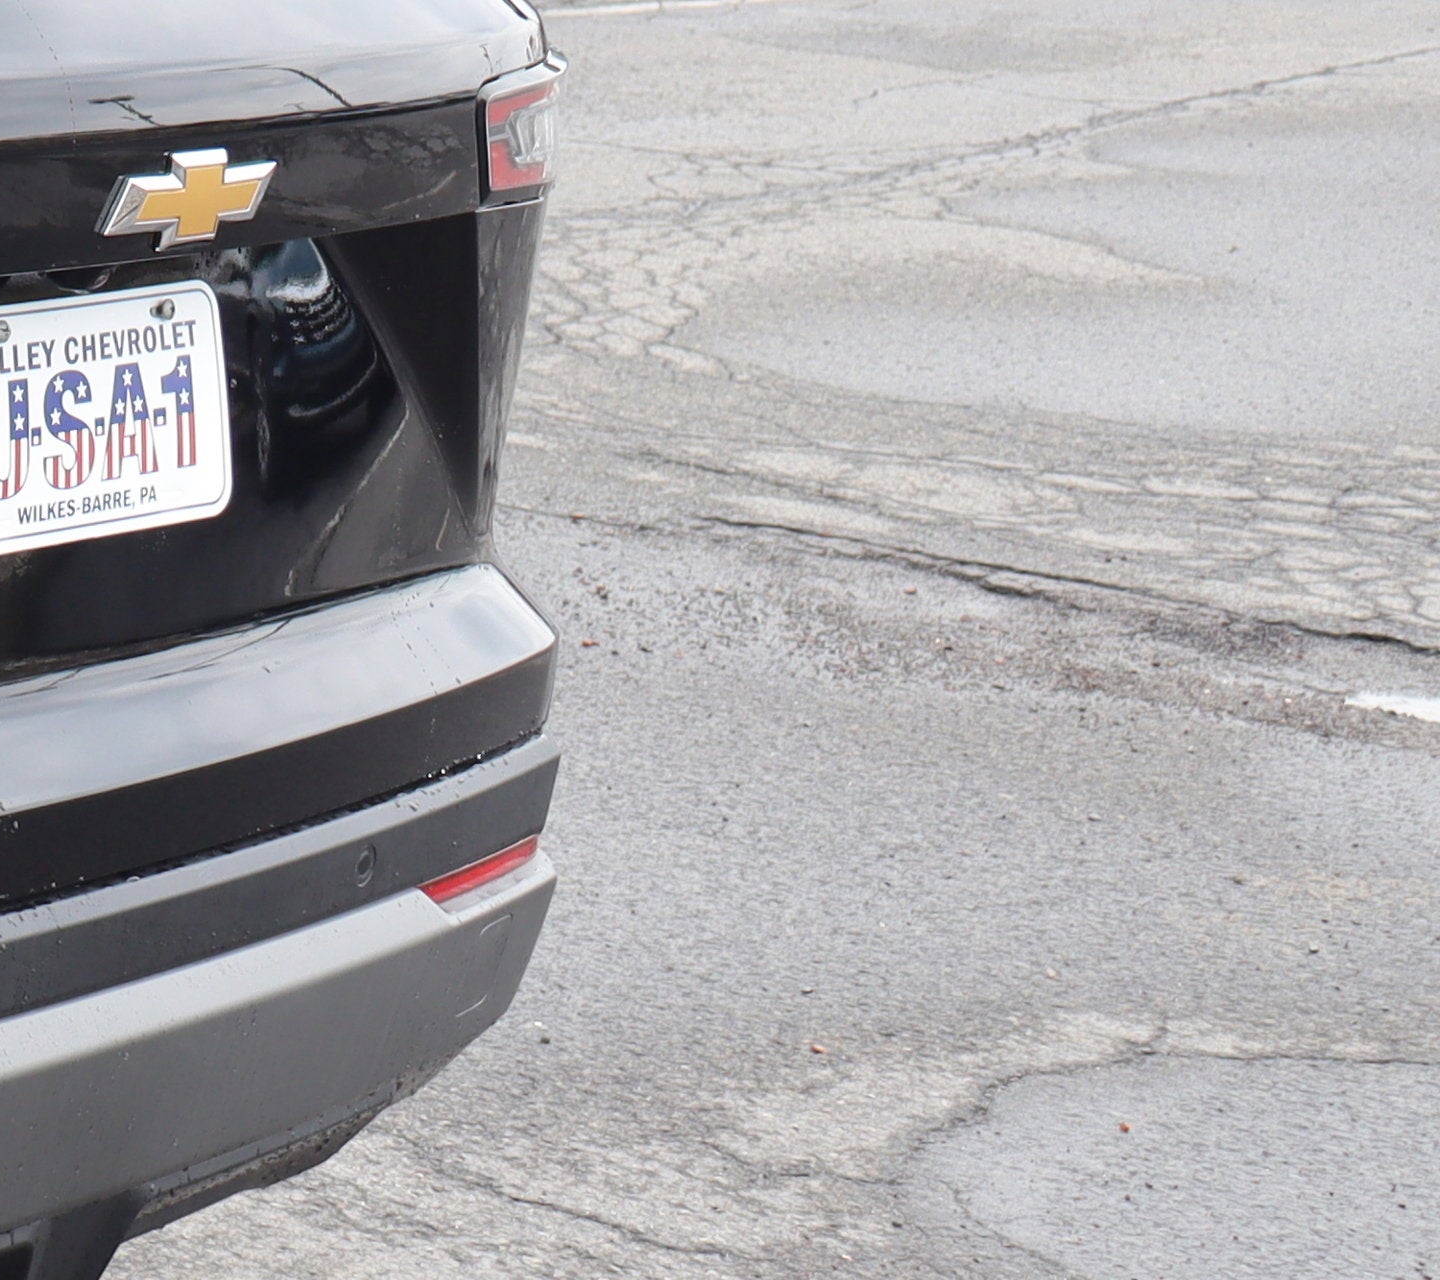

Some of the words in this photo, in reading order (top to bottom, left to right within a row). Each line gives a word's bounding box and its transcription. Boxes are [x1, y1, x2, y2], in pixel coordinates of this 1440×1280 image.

[63, 319, 197, 365] CHEVROLET
[17, 488, 136, 526] WILKES-BARRE,
[139, 484, 158, 504] PA
